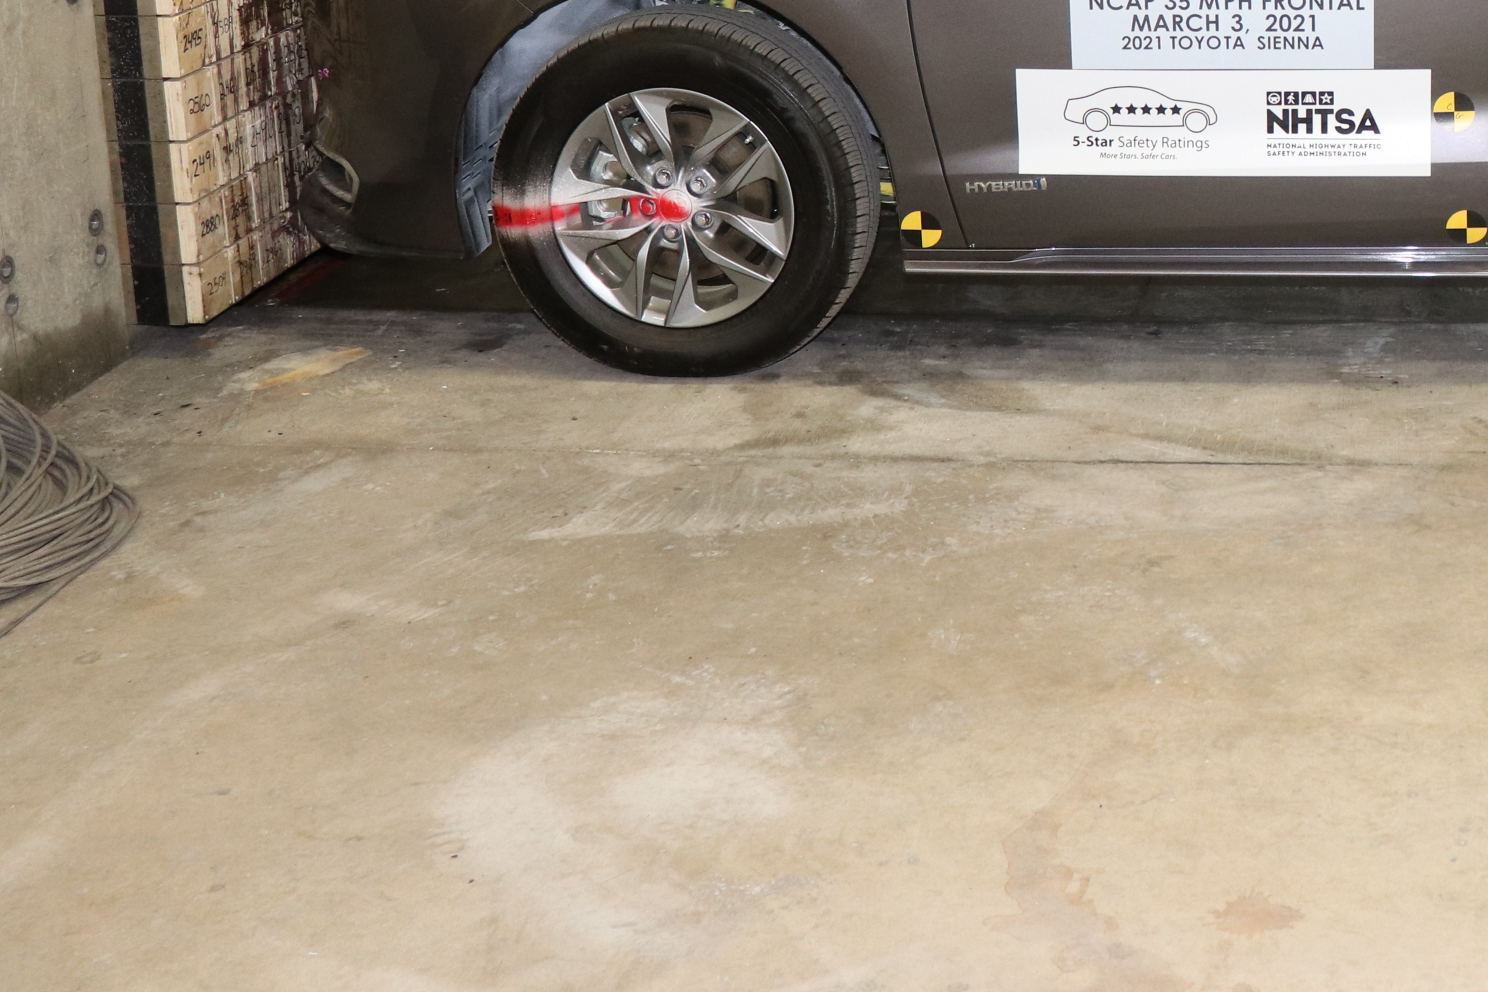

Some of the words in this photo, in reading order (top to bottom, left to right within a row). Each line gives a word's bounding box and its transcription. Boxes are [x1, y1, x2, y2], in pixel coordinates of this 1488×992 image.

[1131, 14, 1220, 32] MARCH
[1231, 14, 1250, 35] 3,
[1265, 14, 1317, 32] 2021
[1121, 36, 1162, 50] 2021
[1170, 36, 1245, 50] TOYOTA
[1257, 36, 1325, 50] SIENNA
[188, 93, 211, 115] 2560
[1266, 108, 1381, 135] NHTSA
[1072, 136, 1114, 147] 5-Star
[1118, 136, 1158, 151] Safety
[1161, 136, 1210, 152] Ratings
[192, 148, 216, 178] 2491
[1119, 152, 1139, 160] Stars.
[965, 180, 1034, 193] HYBRID
